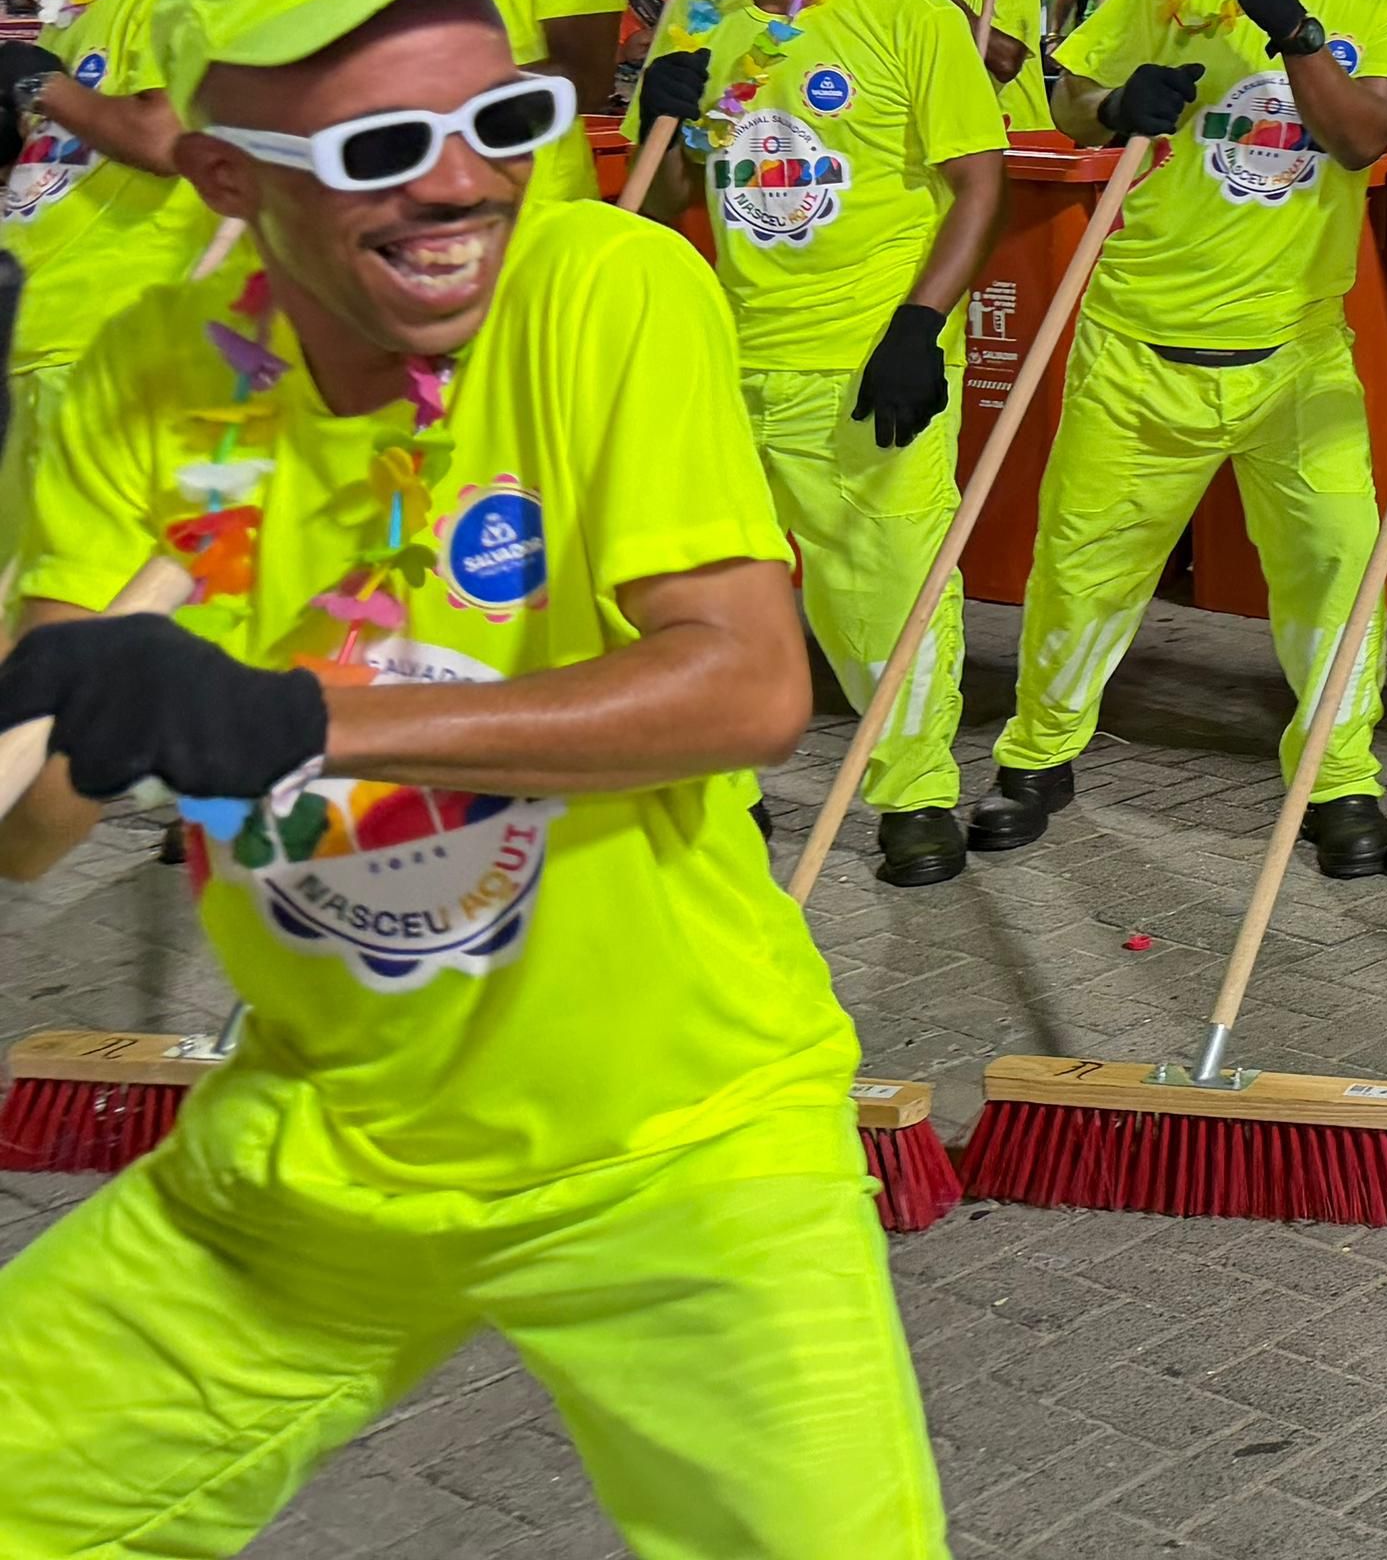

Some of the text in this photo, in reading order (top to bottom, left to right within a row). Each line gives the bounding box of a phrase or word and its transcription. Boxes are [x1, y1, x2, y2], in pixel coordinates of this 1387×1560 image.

[733, 191, 787, 228] NASCEU
[296, 824, 538, 937] NASCEU AQUI
